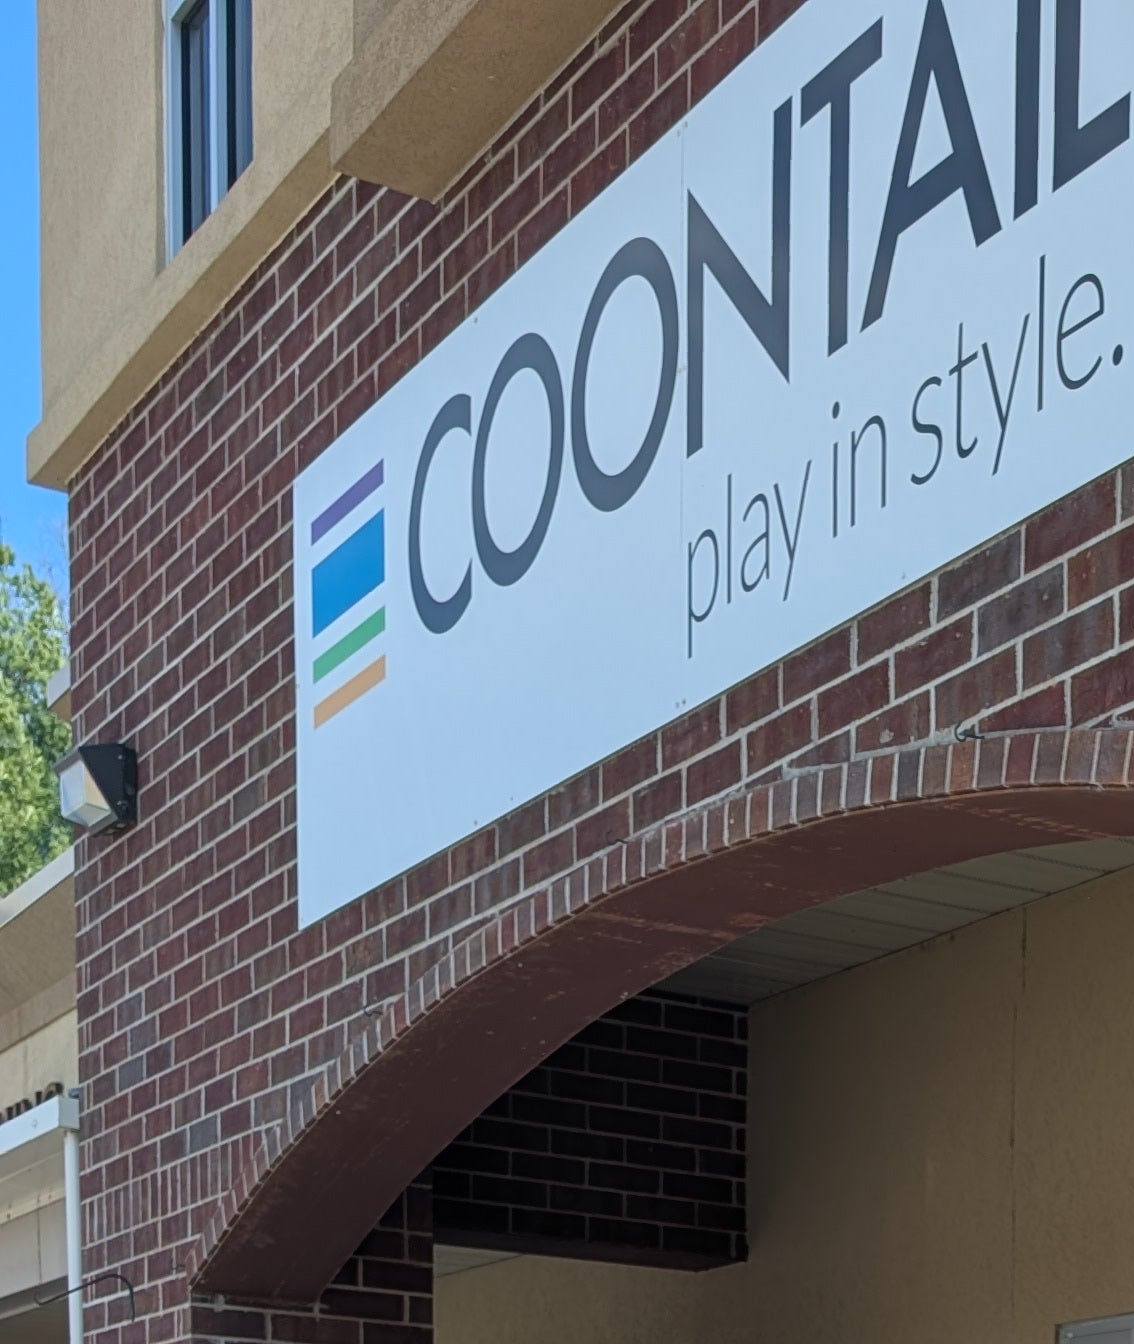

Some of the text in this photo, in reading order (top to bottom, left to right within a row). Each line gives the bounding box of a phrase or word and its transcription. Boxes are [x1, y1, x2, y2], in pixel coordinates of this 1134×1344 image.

[408, 0, 1131, 634] COONTAIL
[687, 254, 1125, 659] play in style.
